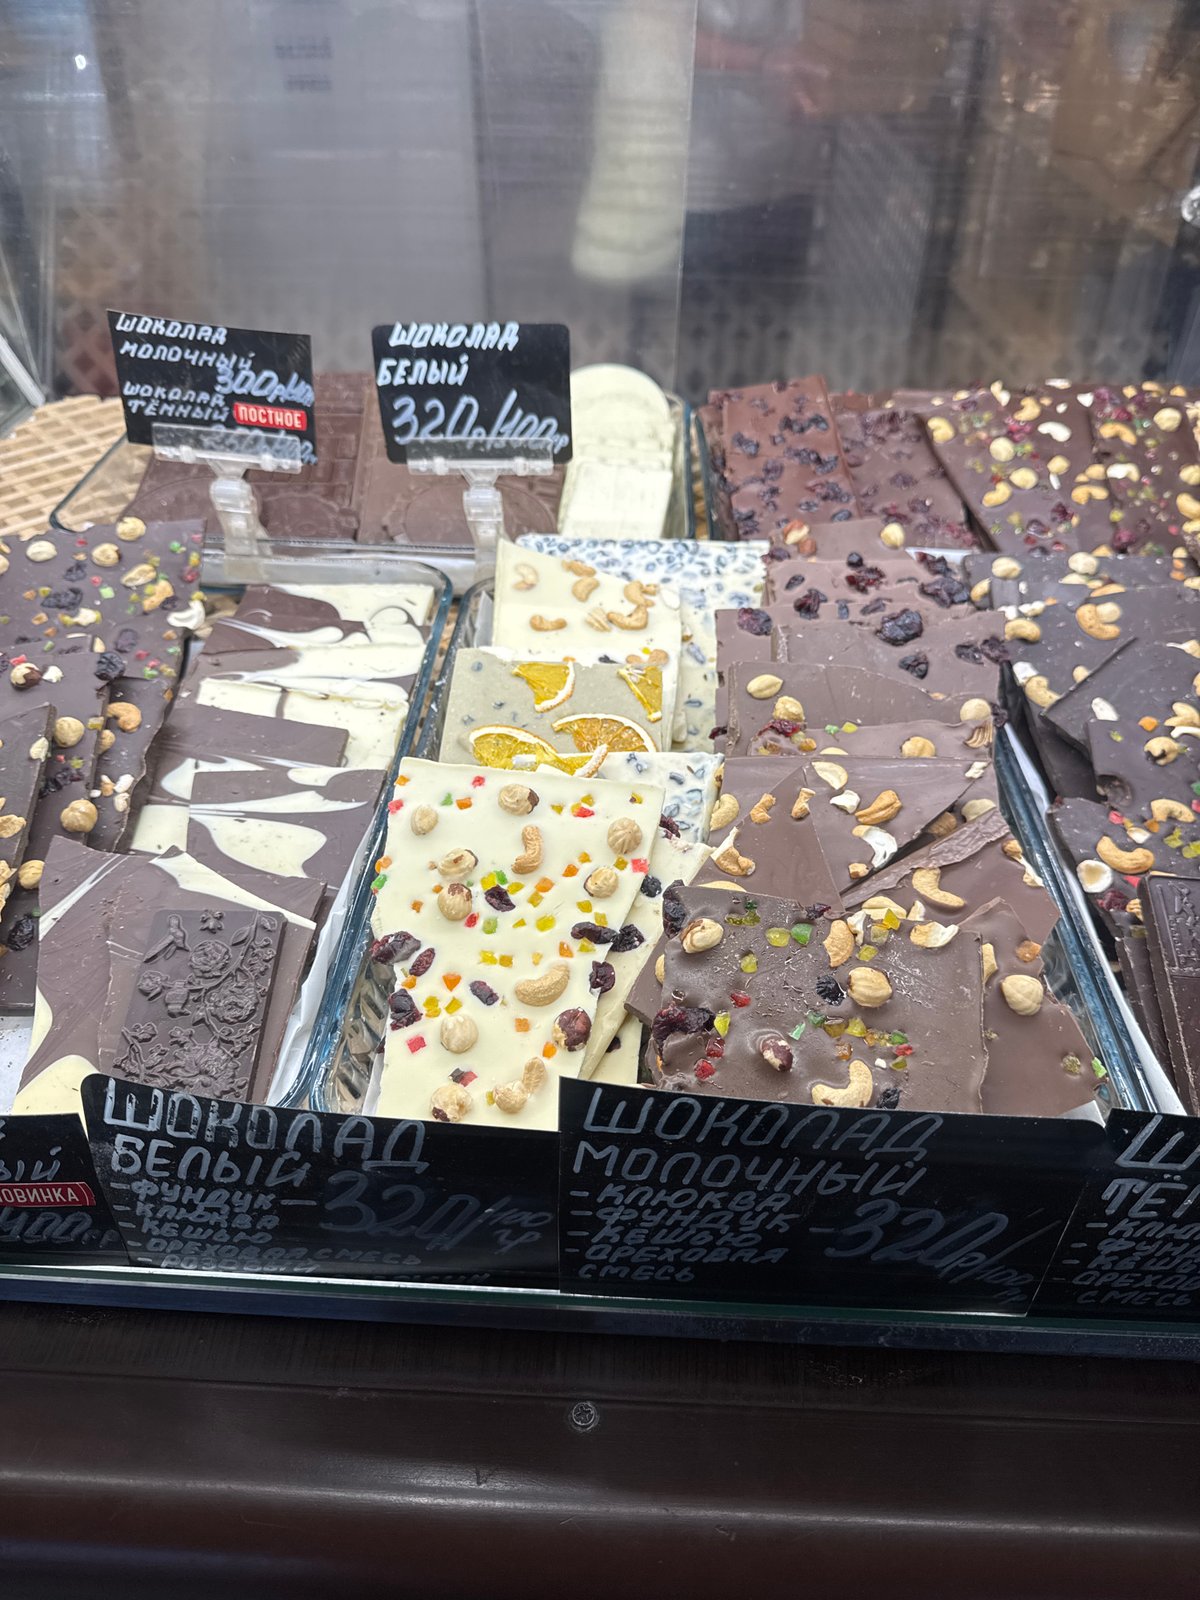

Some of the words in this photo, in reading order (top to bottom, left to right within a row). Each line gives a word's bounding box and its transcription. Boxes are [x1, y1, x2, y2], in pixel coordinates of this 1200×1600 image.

[115, 313, 227, 345] ШОКОЛАД
[389, 321, 519, 352] ШОКОЛАД
[119, 341, 255, 371] МОЛОЧНЫЙ
[376, 352, 469, 387] БЕЛЫЙ
[123, 381, 225, 408] ШОКОЛАД
[238, 406, 302, 428] ПОСТНОЕ
[103, 1078, 430, 1174] ШОКОЛАД
[583, 1087, 944, 1162] ШОКОЛАД
[110, 1133, 311, 1187] БЕЛЫЙ
[573, 1140, 927, 1196] МОЛОЧНЫЙ
[0, 1186, 79, 1204] ОВИНКА
[131, 1179, 276, 1214] ФУНДУК
[596, 1183, 791, 1213] КЛЮКВА
[136, 1201, 280, 1230] КЛЮКВА
[595, 1205, 800, 1234] ФУНДУК
[1107, 1218, 1200, 1242] КЛЮ
[141, 1217, 273, 1244] КЕШЬЮ
[591, 1224, 762, 1247] КЕШЬЮ
[146, 1237, 308, 1260] ОРЕХОВАЯ
[314, 1247, 422, 1266] СМЕСЬ
[585, 1244, 789, 1264] ОРЕХОВАЯ
[1087, 1255, 1200, 1275] КЕШЬ
[578, 1263, 695, 1283] СМЕСЬ
[1076, 1290, 1192, 1308] СМЕСЬ
